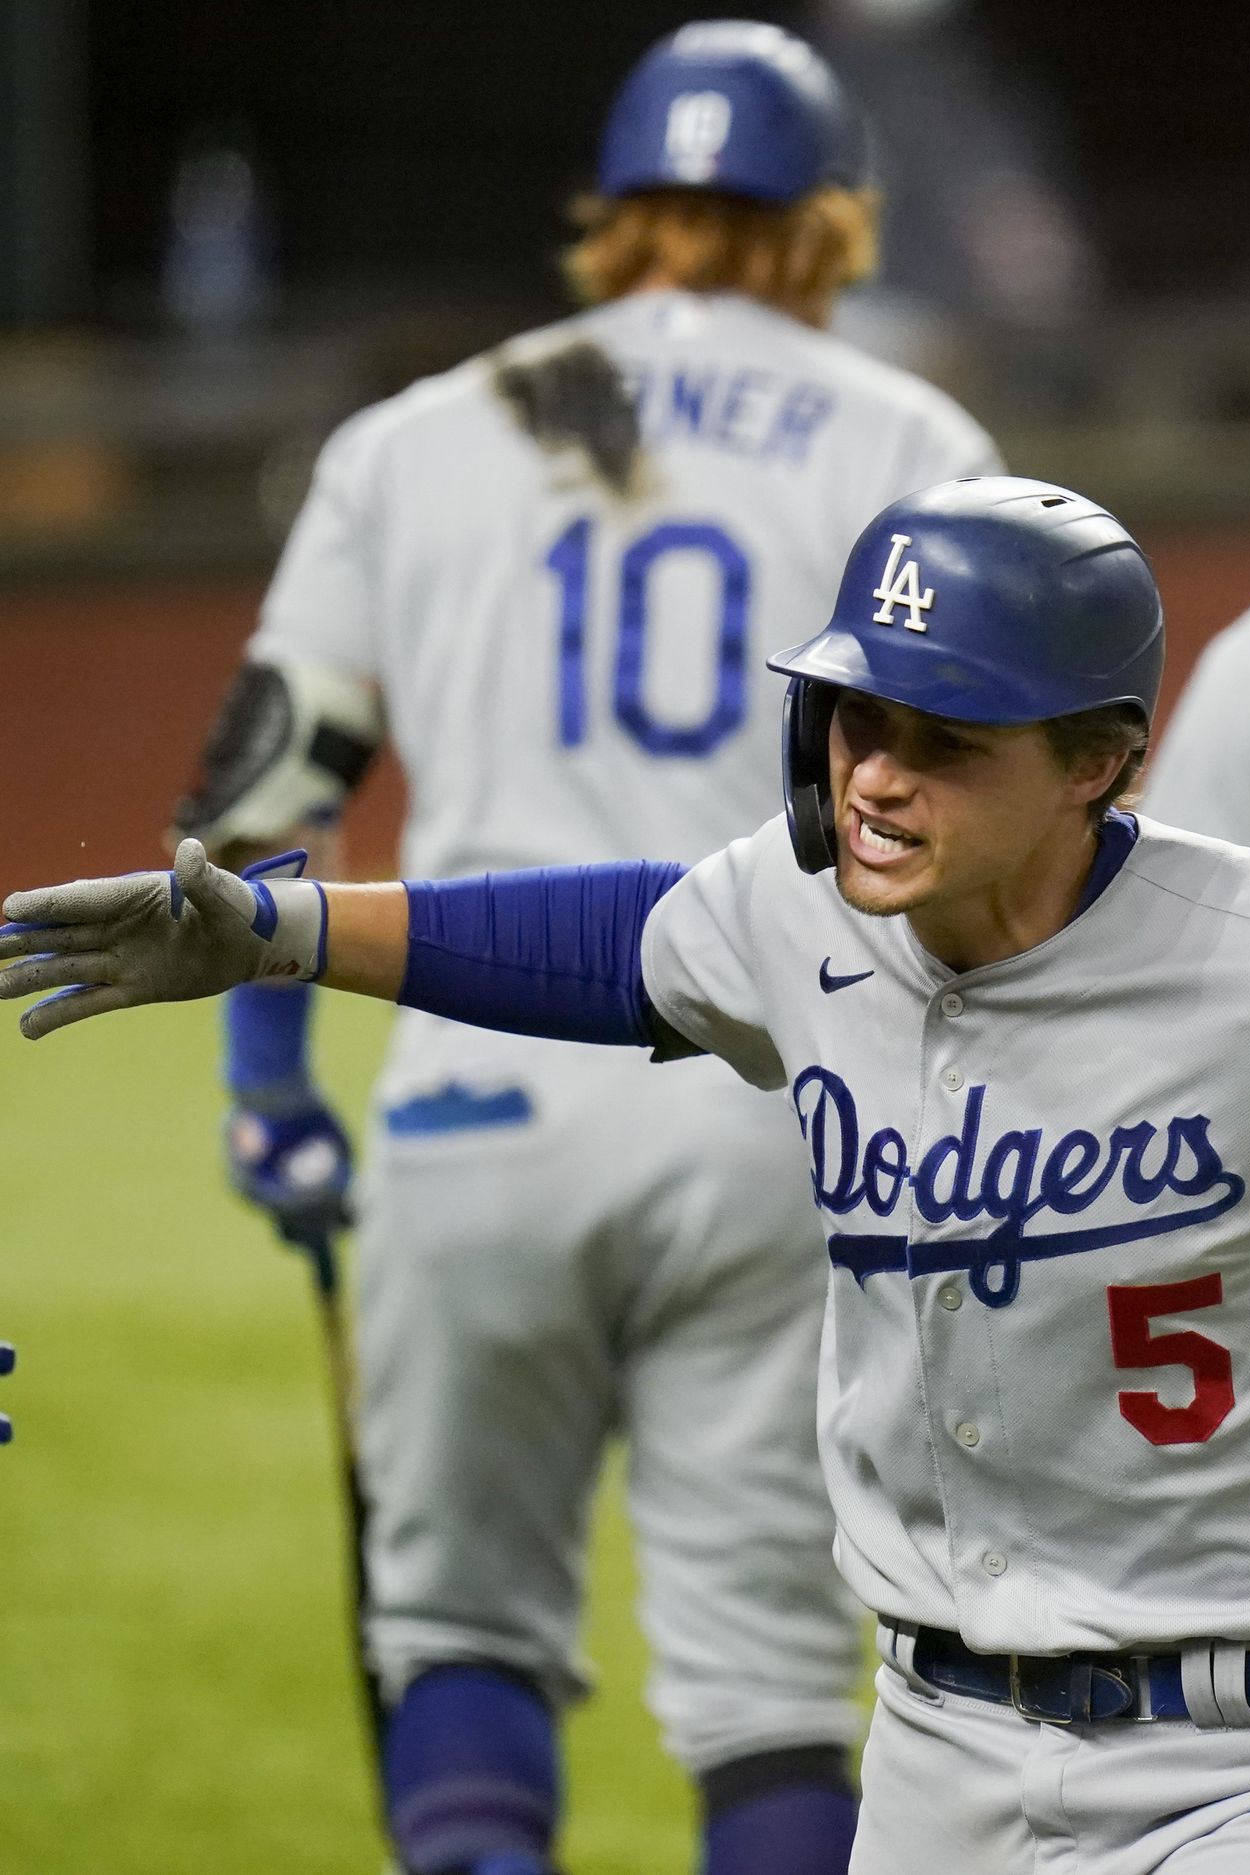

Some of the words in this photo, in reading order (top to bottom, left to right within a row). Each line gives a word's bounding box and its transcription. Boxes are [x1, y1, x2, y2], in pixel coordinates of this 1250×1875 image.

[546, 518, 752, 760] 10
[872, 533, 935, 632] LA
[793, 1065, 1246, 1309] Dodgers
[1106, 1272, 1236, 1446] 5
